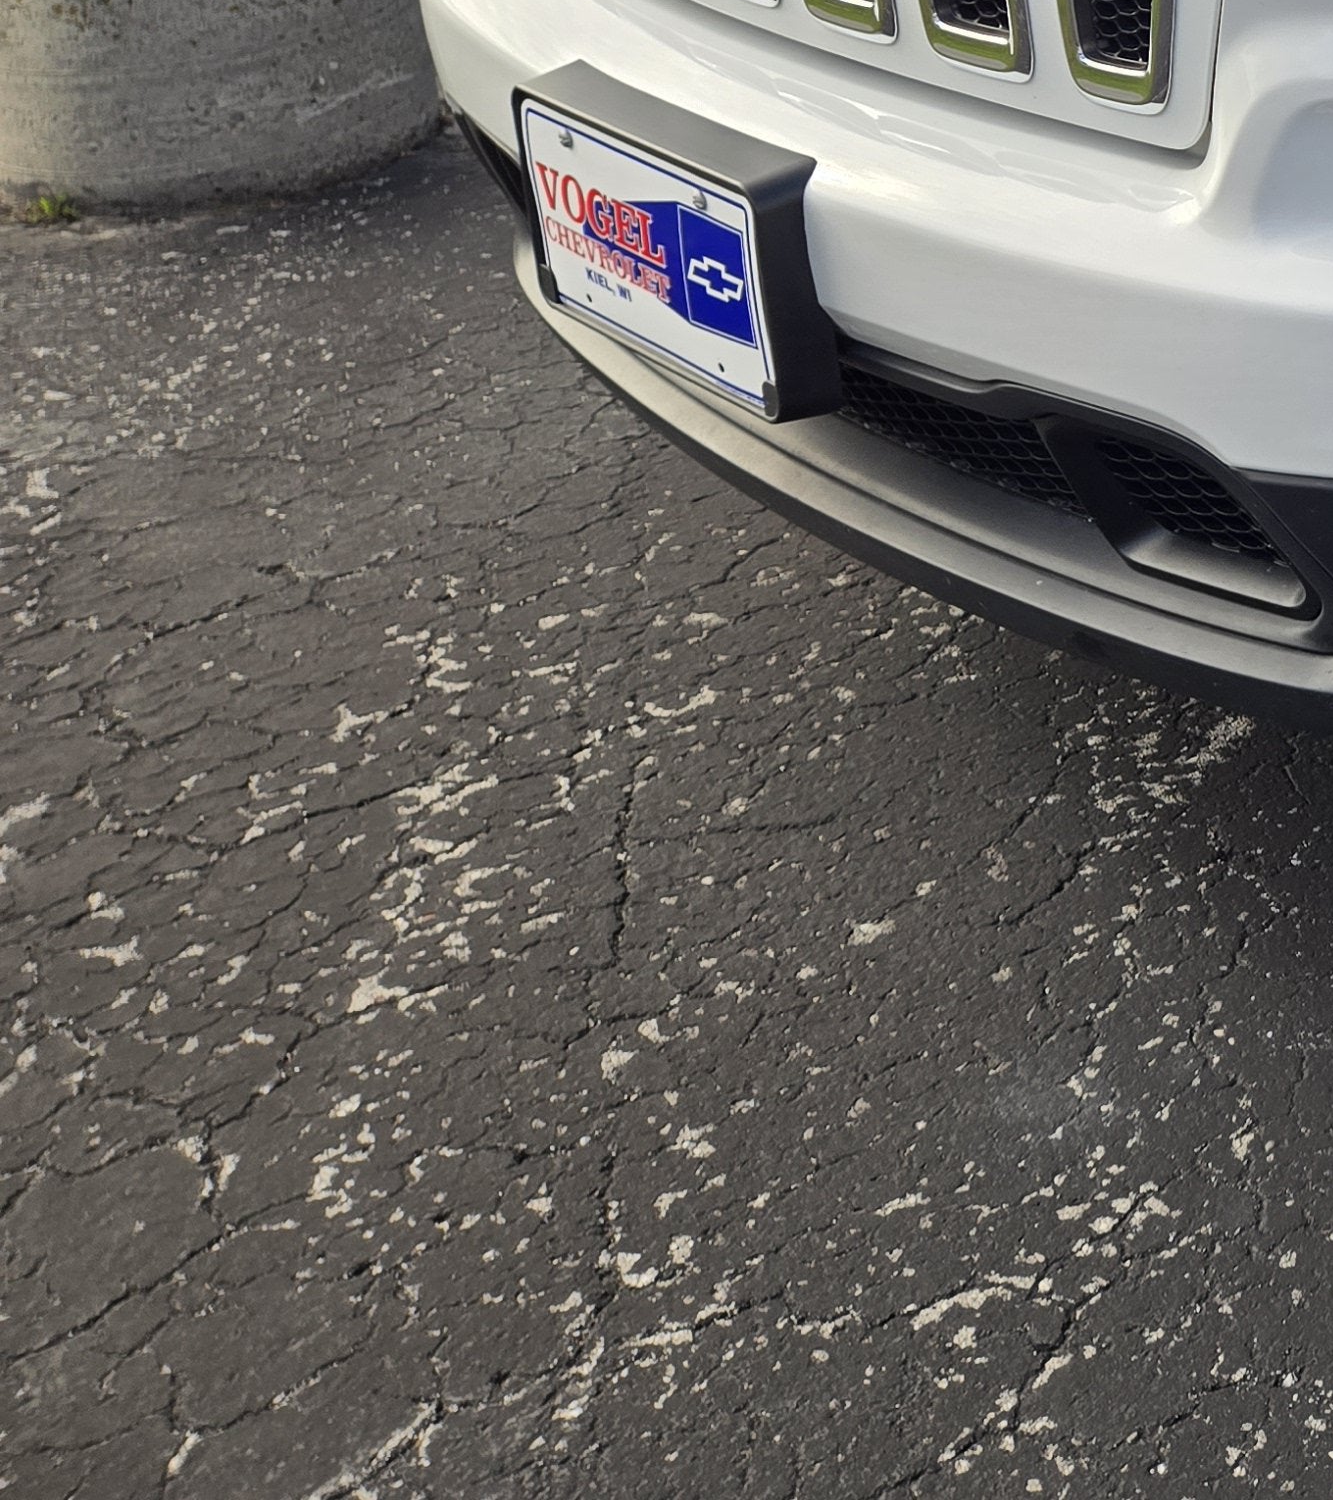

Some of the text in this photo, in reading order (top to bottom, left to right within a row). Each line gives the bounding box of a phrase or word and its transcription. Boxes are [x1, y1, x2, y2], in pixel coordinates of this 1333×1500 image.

[535, 160, 666, 269] VOGEL
[545, 215, 672, 304] CHEVROLET
[616, 283, 633, 302] WI
